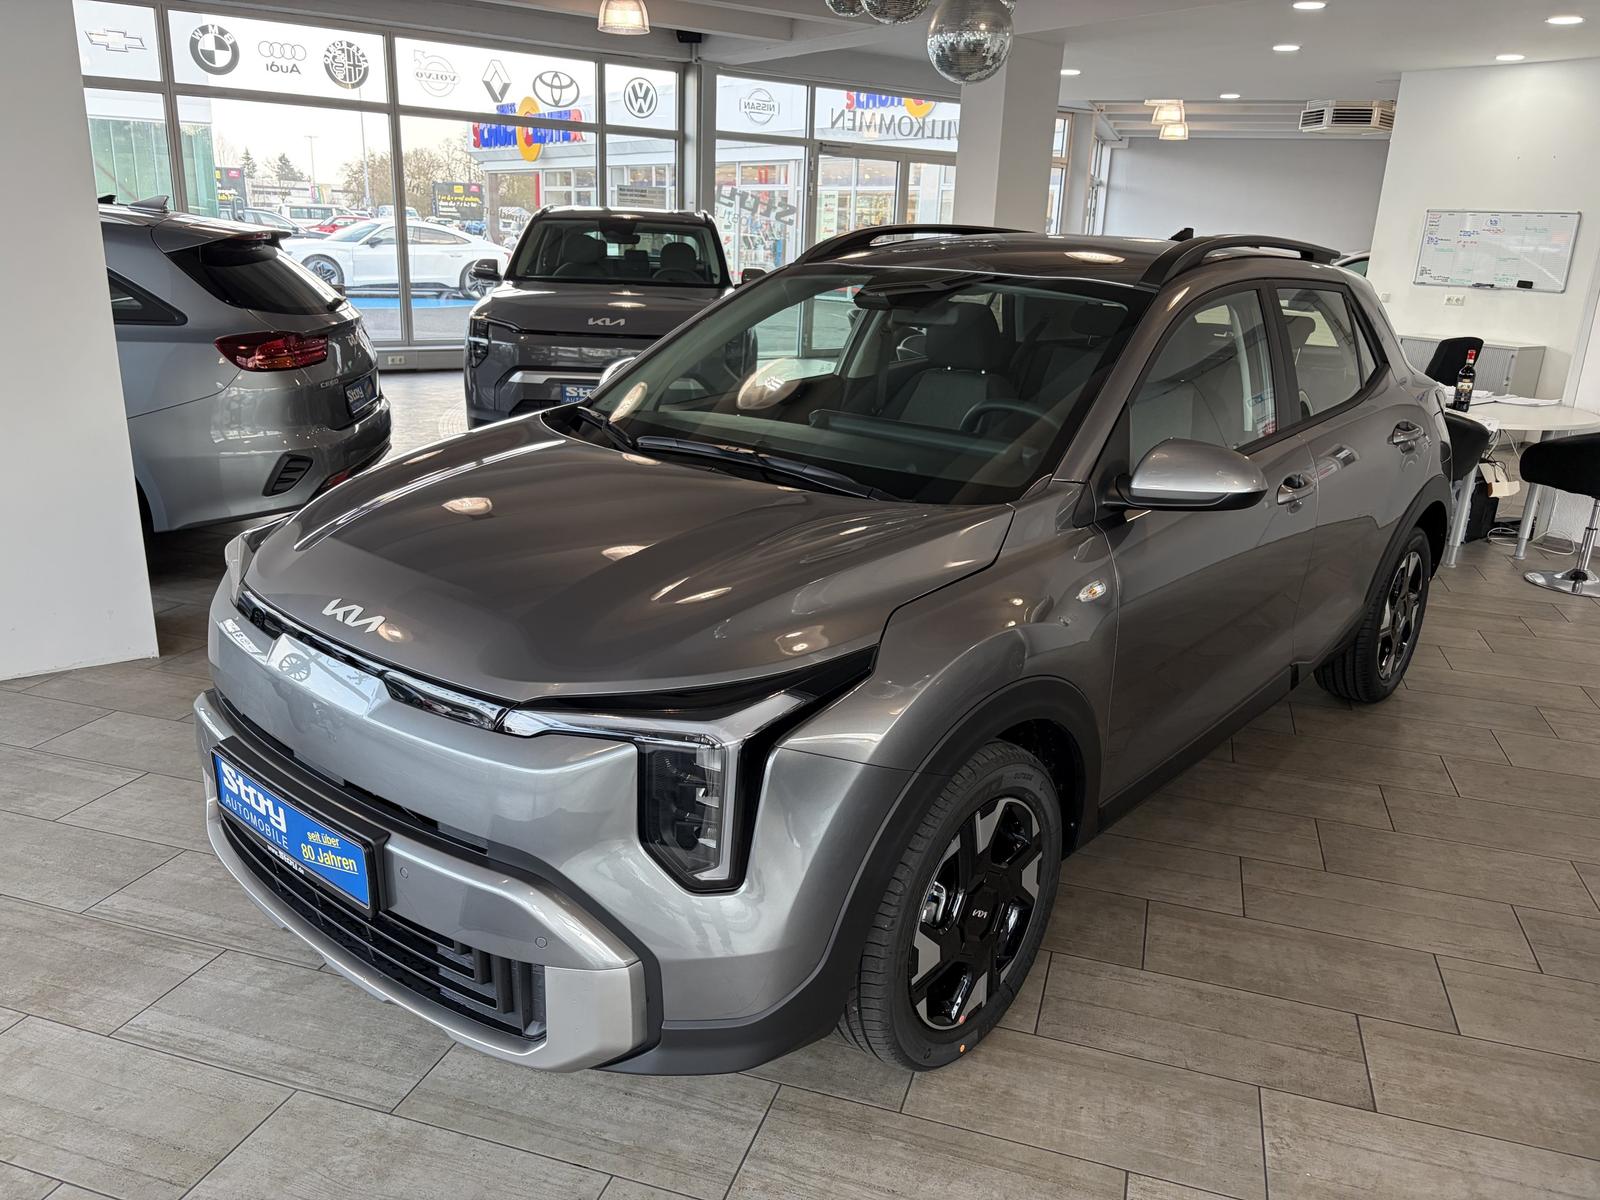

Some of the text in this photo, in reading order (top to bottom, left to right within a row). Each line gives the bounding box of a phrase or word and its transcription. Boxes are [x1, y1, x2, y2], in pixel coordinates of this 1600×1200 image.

[321, 598, 386, 634] KIA
[225, 793, 289, 850] AUTOMOBILE
[306, 830, 340, 848] seit über
[301, 843, 358, 872] 80 Jahren
